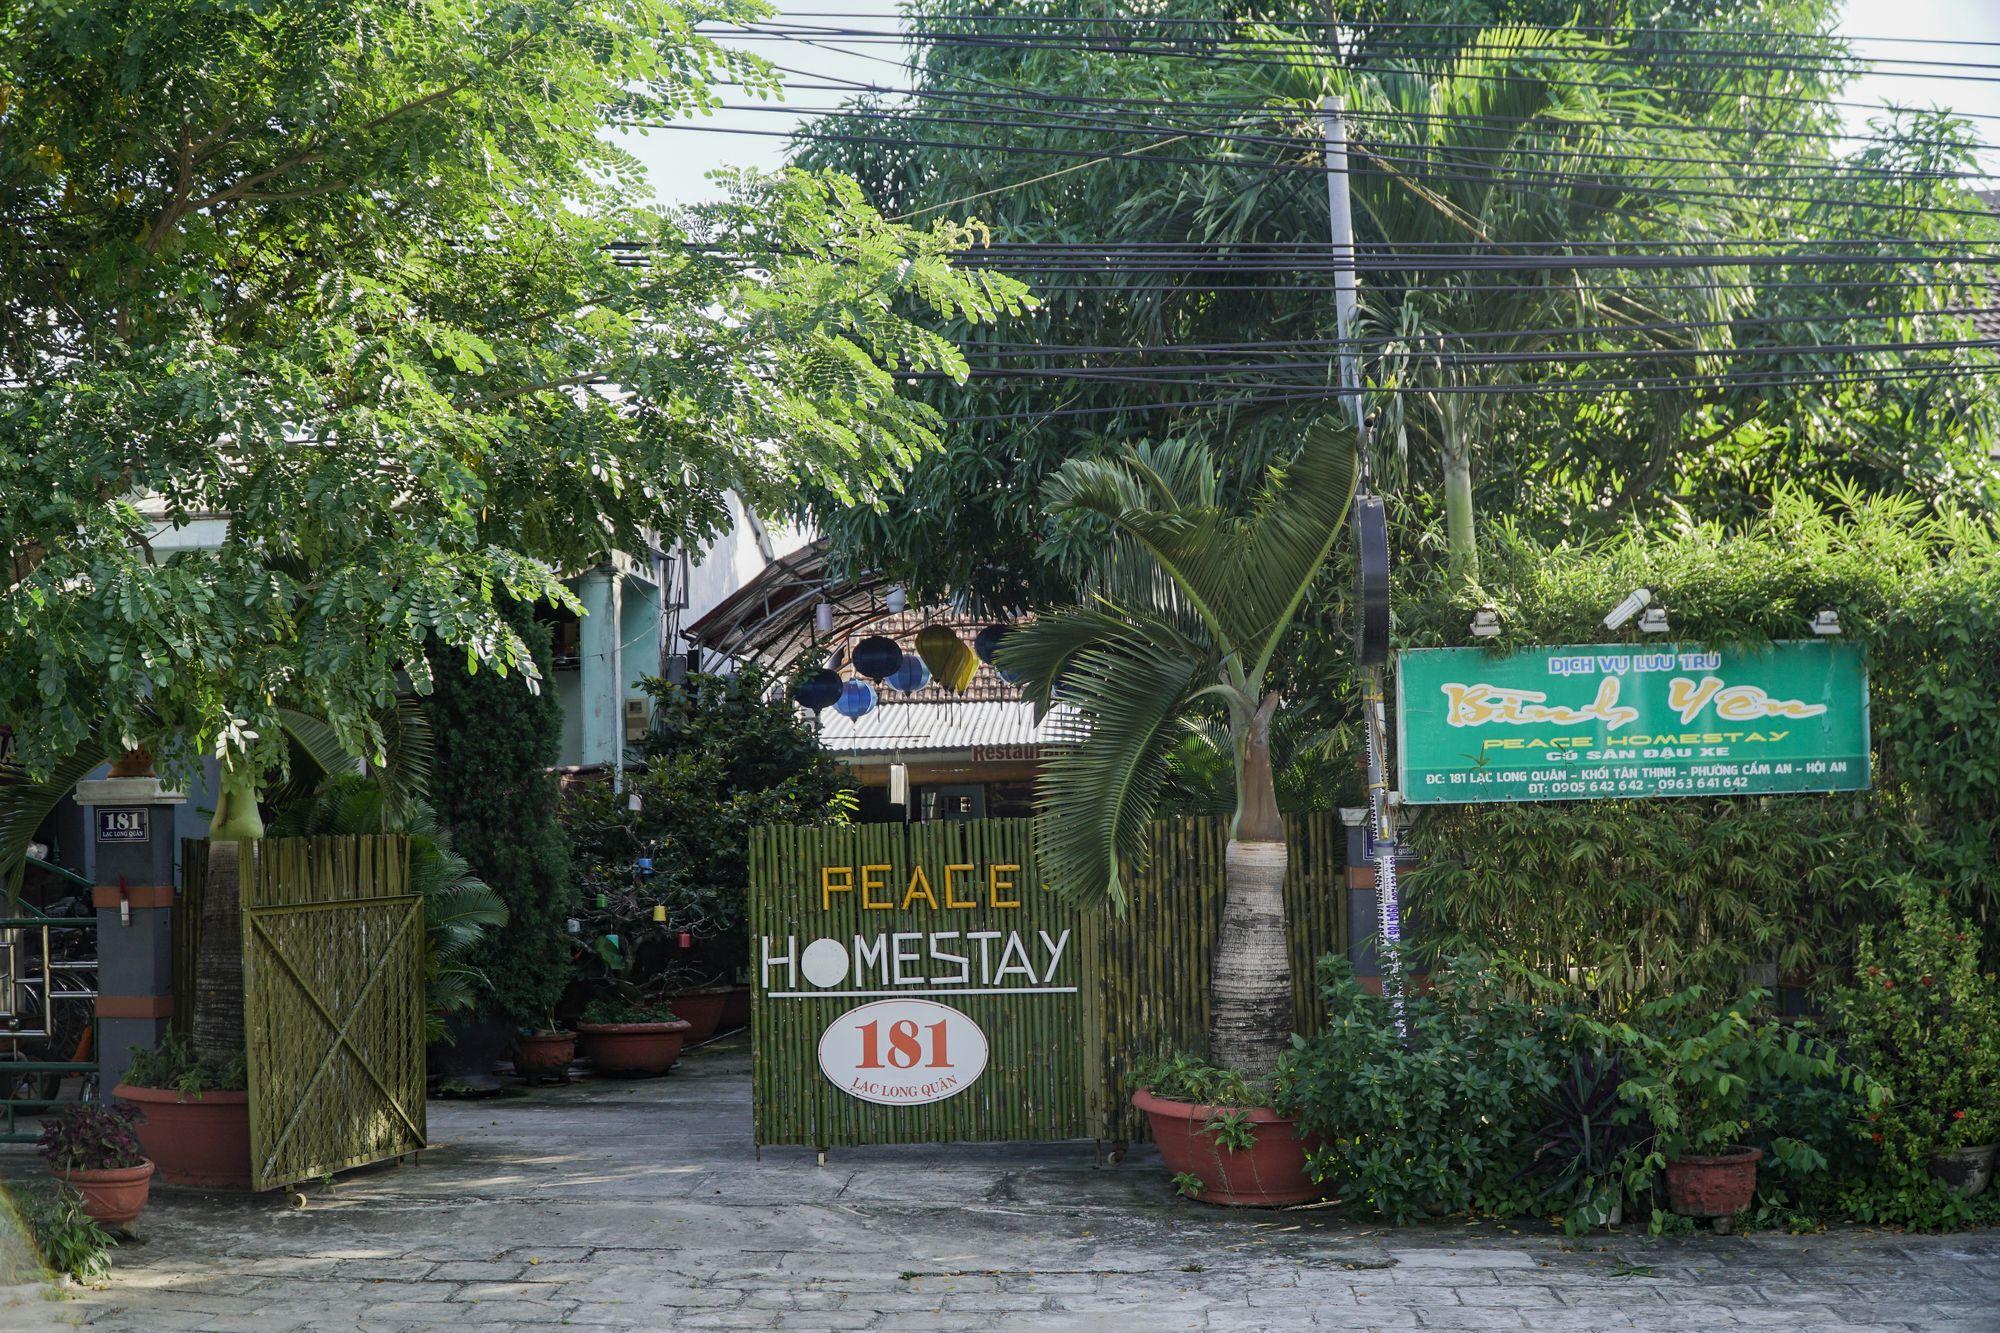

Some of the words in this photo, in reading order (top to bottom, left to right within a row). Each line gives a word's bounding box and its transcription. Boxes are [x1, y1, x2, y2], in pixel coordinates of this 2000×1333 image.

[1549, 656, 1594, 676] DỊCH
[1599, 655, 1629, 675] VỤ
[1484, 737, 1593, 750] PEACE
[1606, 730, 1790, 746] HOMESTAY
[1700, 747, 1730, 757] XE
[1449, 773, 1466, 783] 181
[1497, 771, 1527, 782] LONG
[1531, 768, 1567, 781] QUÂN
[1582, 766, 1609, 780] KHỐI
[1613, 766, 1638, 779] TÂN
[1642, 766, 1676, 780] THỊNH
[1775, 764, 1792, 775] AN
[1830, 762, 1847, 772] AN
[1528, 785, 1548, 794] ĐT:
[1552, 782, 1585, 793] 0905
[1589, 781, 1615, 792] 642
[1619, 780, 1643, 791] 642
[1659, 779, 1693, 790] 0963
[1697, 777, 1719, 788] 641
[1723, 776, 1748, 787] 642
[105, 812, 141, 830] 181
[822, 864, 1020, 910] PEACE
[762, 929, 1070, 988] HOMESTAY
[854, 1018, 955, 1069] 181
[881, 1086, 918, 1097] LONG
[921, 1075, 958, 1096] QUÂN
